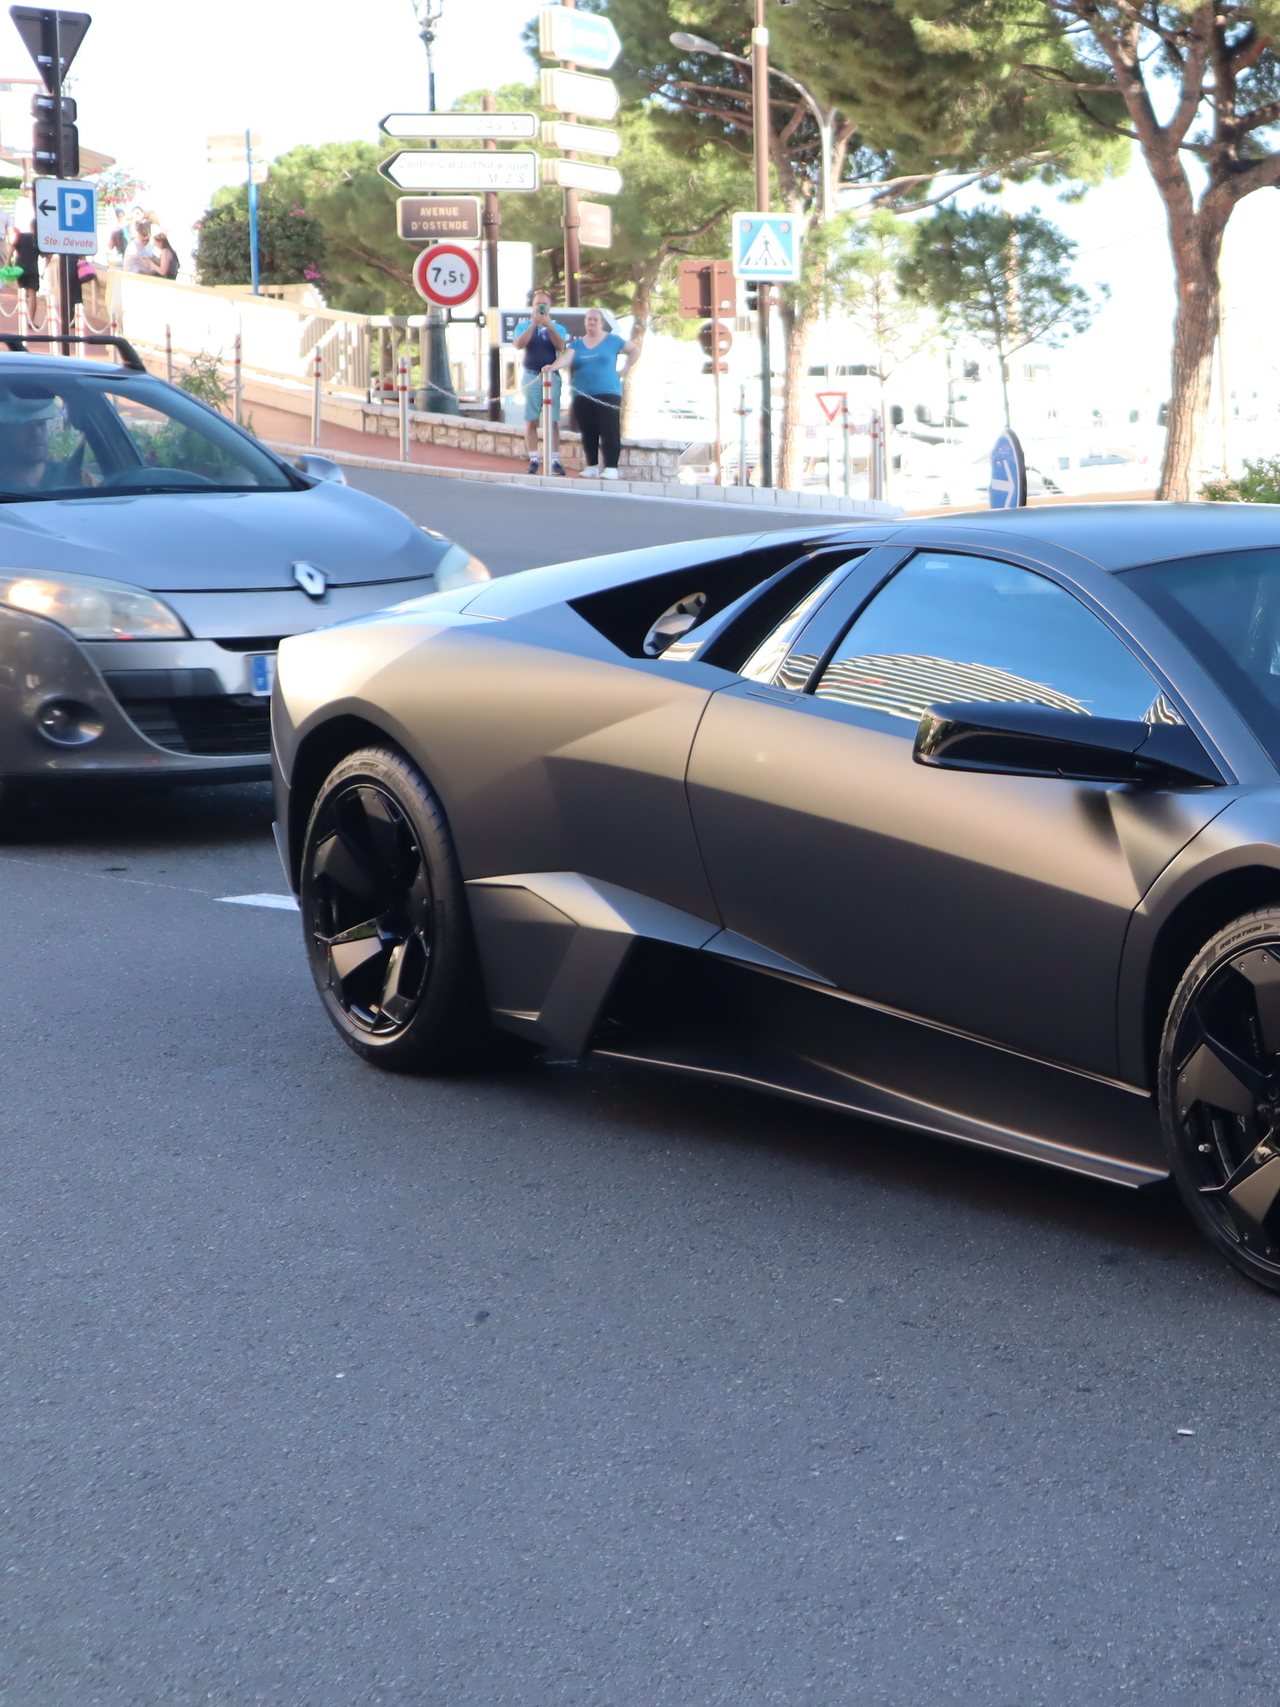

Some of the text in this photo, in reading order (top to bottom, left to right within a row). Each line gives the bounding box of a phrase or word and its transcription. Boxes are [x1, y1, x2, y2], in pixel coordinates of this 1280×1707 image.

[475, 120, 528, 131] CASINO
[398, 158, 434, 169] Centre
[64, 192, 87, 227] P
[420, 206, 459, 216] AVENUE
[410, 221, 469, 230] D'OSTENDE
[43, 236, 94, 248] Ste. Dévote
[1219, 923, 1262, 951] ROTATION
